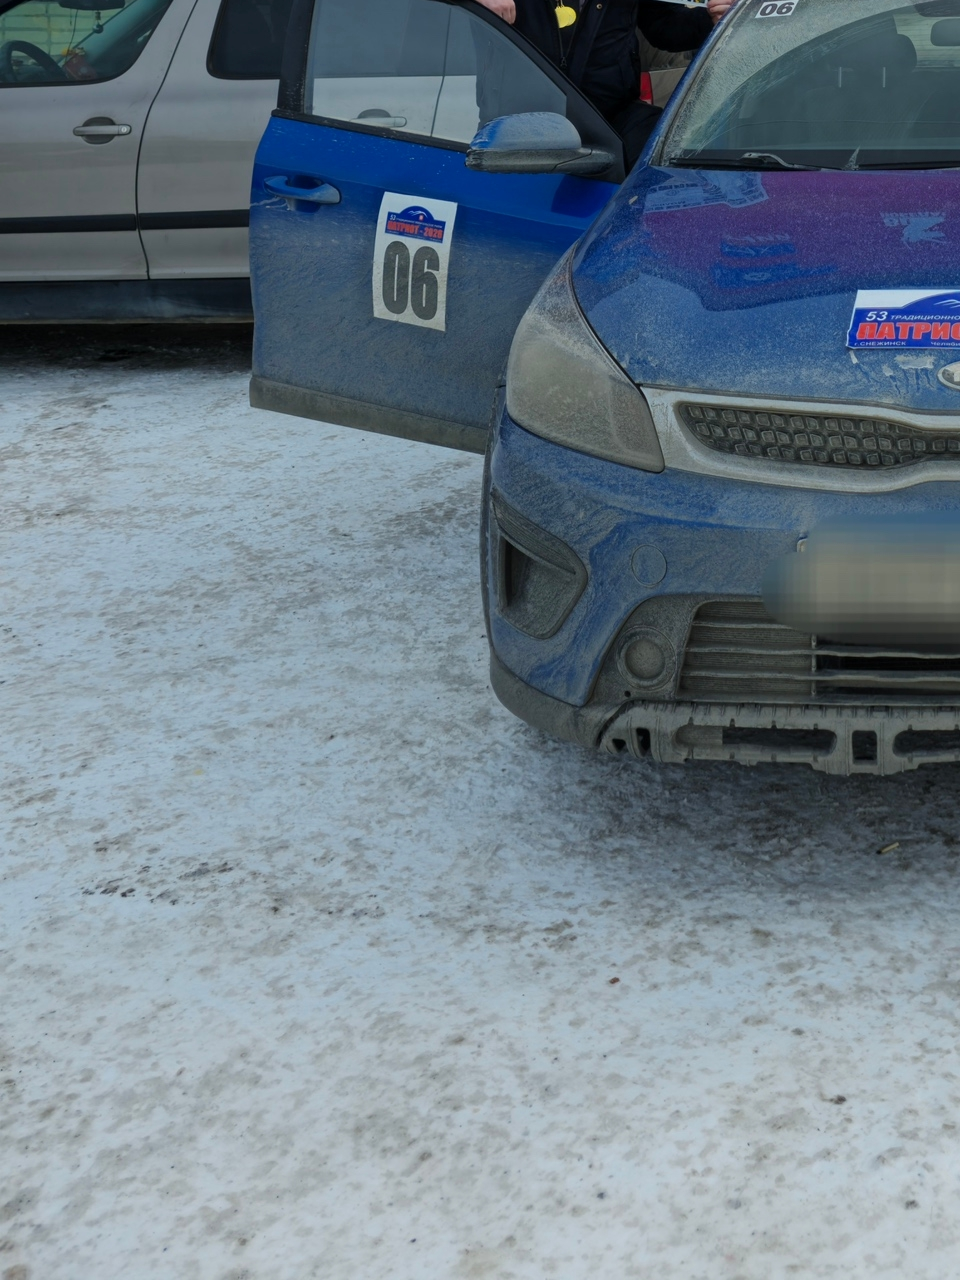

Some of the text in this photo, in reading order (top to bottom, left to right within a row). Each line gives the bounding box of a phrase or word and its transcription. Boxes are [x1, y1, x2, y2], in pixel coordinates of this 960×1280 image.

[760, 2, 794, 16] 06
[382, 240, 440, 320] 06
[865, 311, 888, 321] 53
